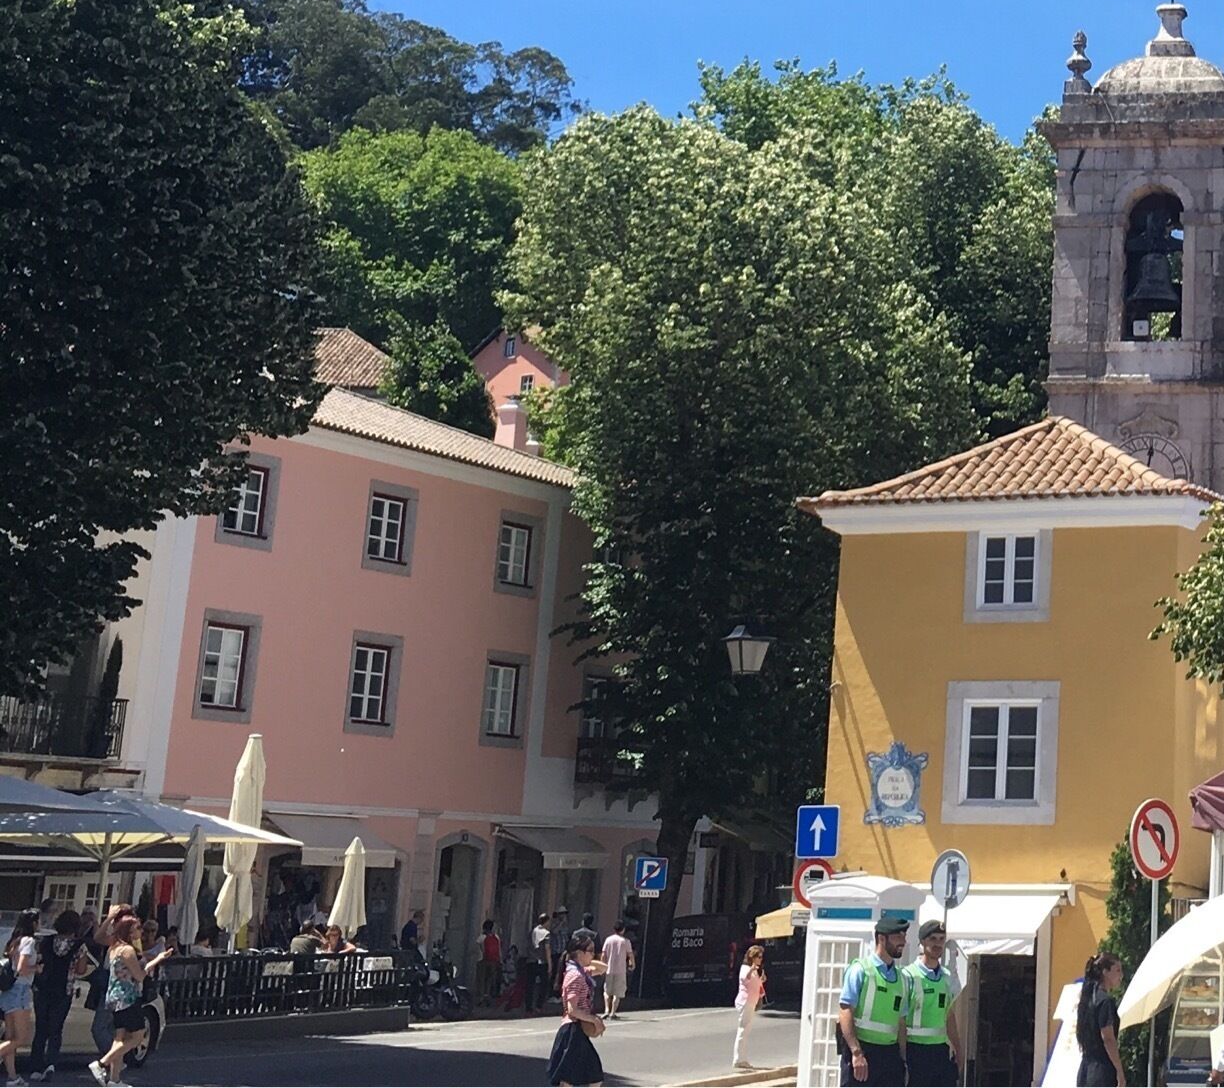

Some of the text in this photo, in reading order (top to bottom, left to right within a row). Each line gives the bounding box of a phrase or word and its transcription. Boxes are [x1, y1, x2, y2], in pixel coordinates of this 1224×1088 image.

[672, 927, 704, 938] Romaria
[672, 937, 704, 948] de Baco
